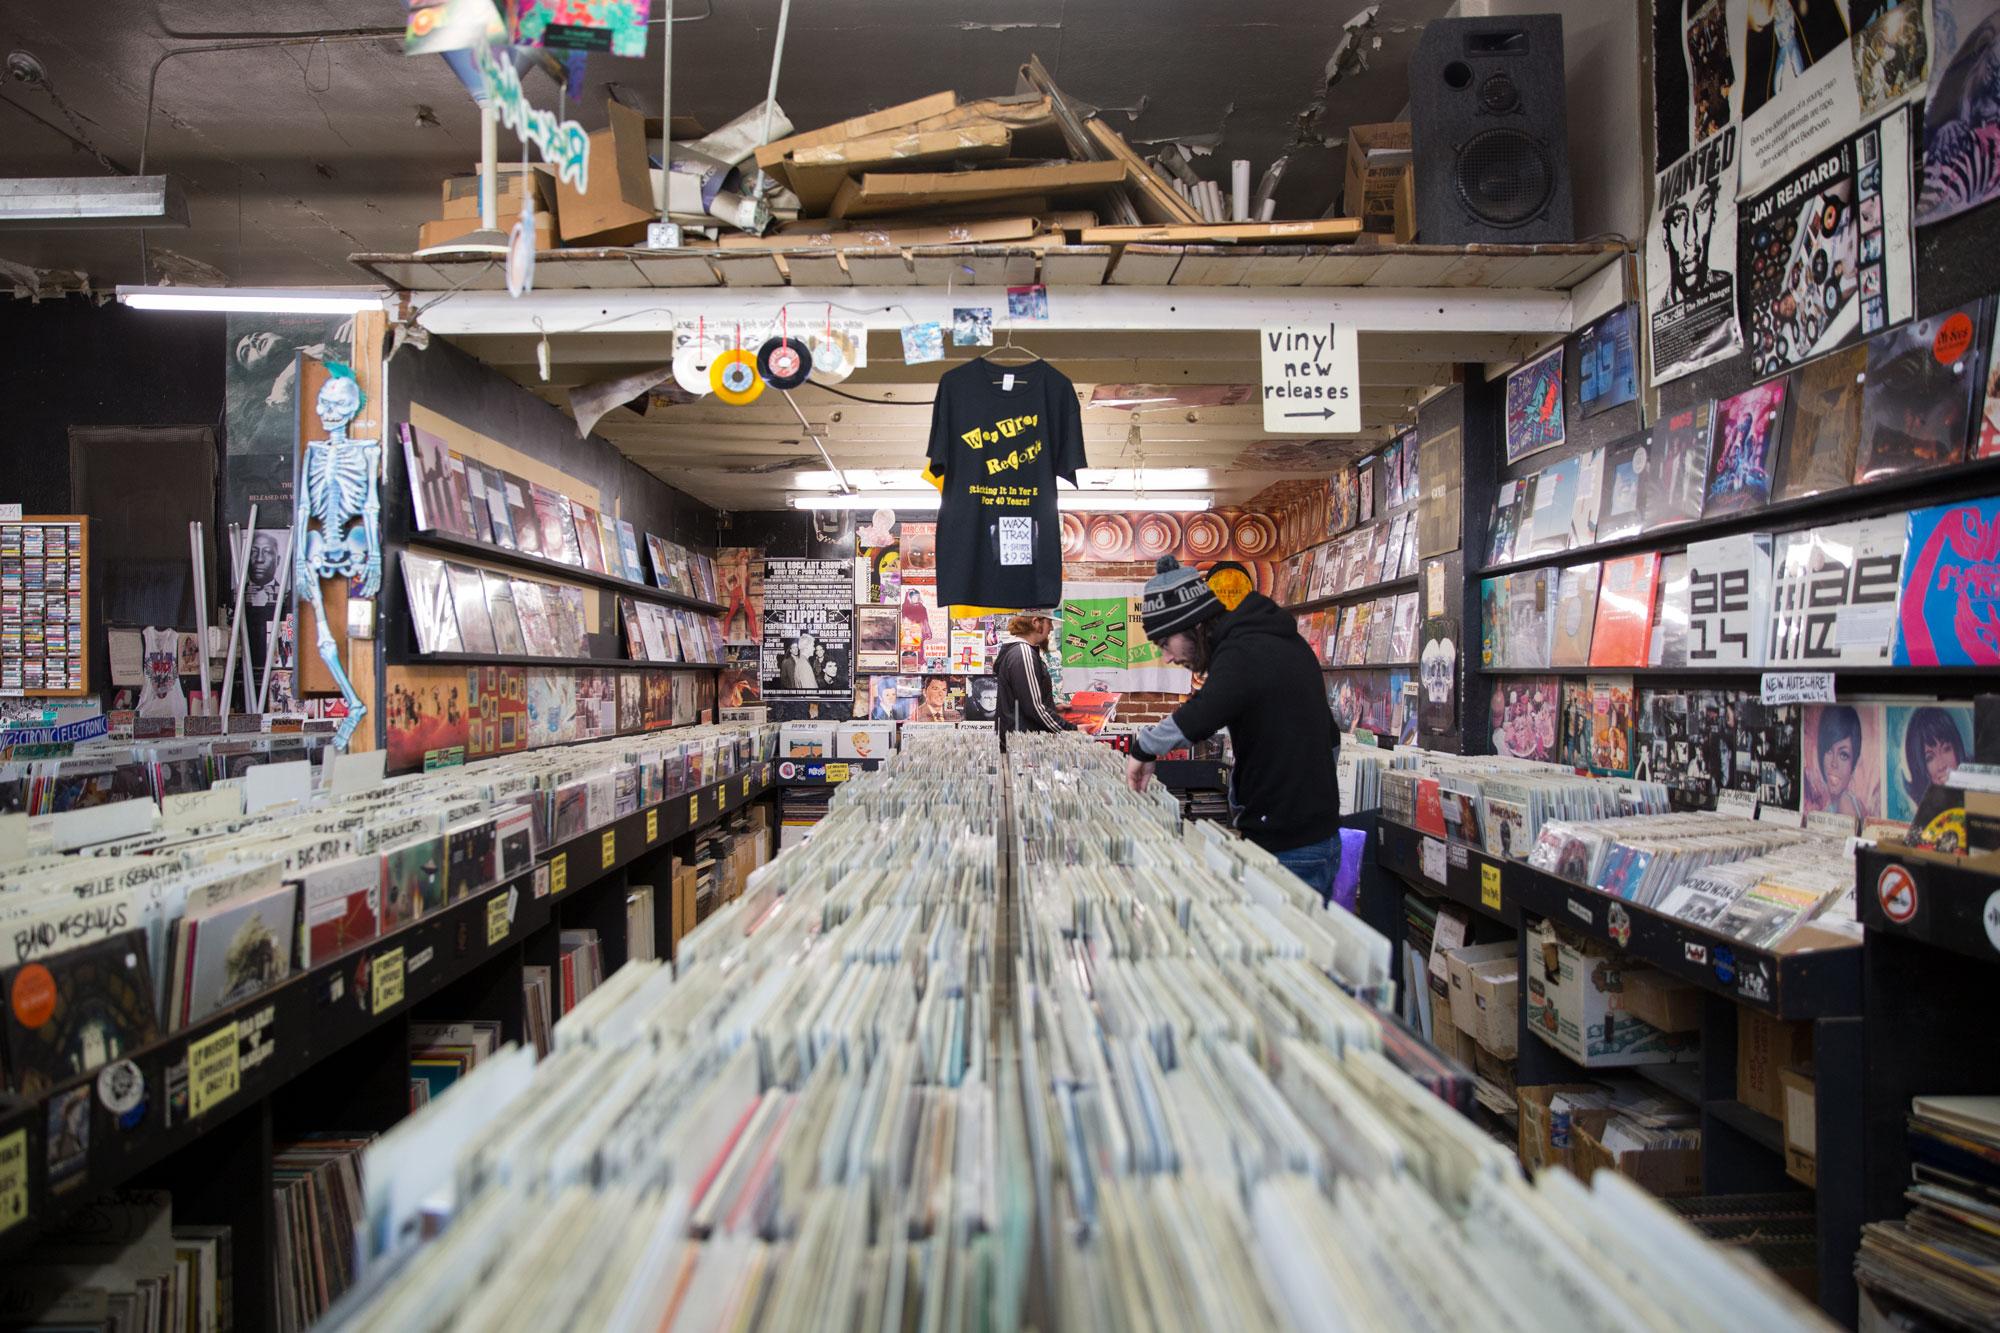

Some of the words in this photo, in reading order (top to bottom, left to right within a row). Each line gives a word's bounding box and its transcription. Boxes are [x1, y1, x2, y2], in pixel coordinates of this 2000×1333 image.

[1658, 126, 1736, 211] WANTED
[1752, 199, 1774, 224] JAY
[1777, 157, 1840, 208] REATARD
[1269, 322, 1334, 362] vinyl
[1285, 362, 1332, 377] new
[1264, 380, 1349, 399] releases
[969, 485, 998, 496] Sticking
[999, 486, 1007, 495] It
[1009, 486, 1017, 495] In
[1019, 487, 1032, 496] Yer
[982, 496, 994, 505] For
[995, 497, 1005, 505] 40
[1006, 497, 1030, 506] Years!
[1002, 518, 1029, 529] WAX
[1001, 530, 1030, 540] TRAX
[768, 561, 786, 569] PUNK
[787, 561, 805, 569] ROCK
[806, 561, 819, 569] ART
[785, 610, 827, 623] FLIPPER
[1765, 677, 1783, 692] NEW
[61, 718, 107, 741] ELECTRONIC
[126, 861, 184, 888] SEBASTIAN
